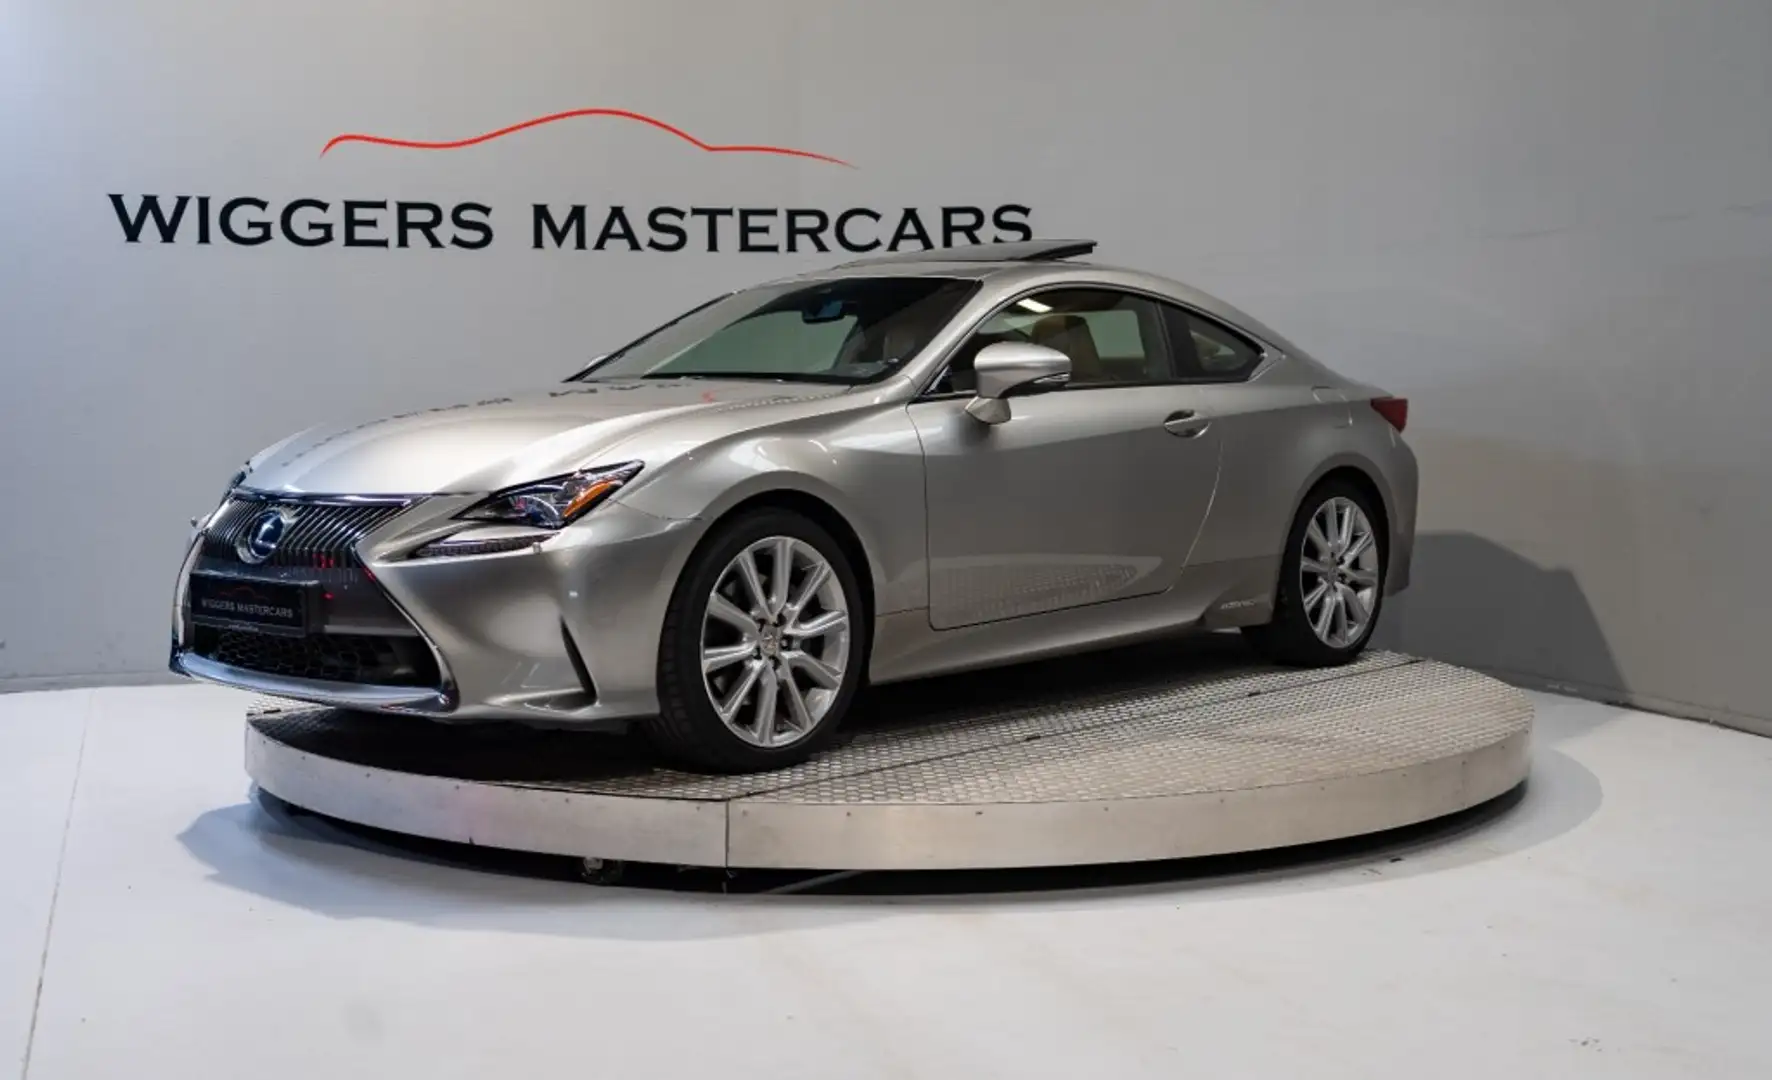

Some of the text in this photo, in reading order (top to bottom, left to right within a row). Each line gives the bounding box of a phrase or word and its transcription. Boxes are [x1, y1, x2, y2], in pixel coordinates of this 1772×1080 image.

[107, 193, 1033, 254] WIGGERS MASTERCARS
[201, 598, 294, 619] WIGGERS MASTERCARS
